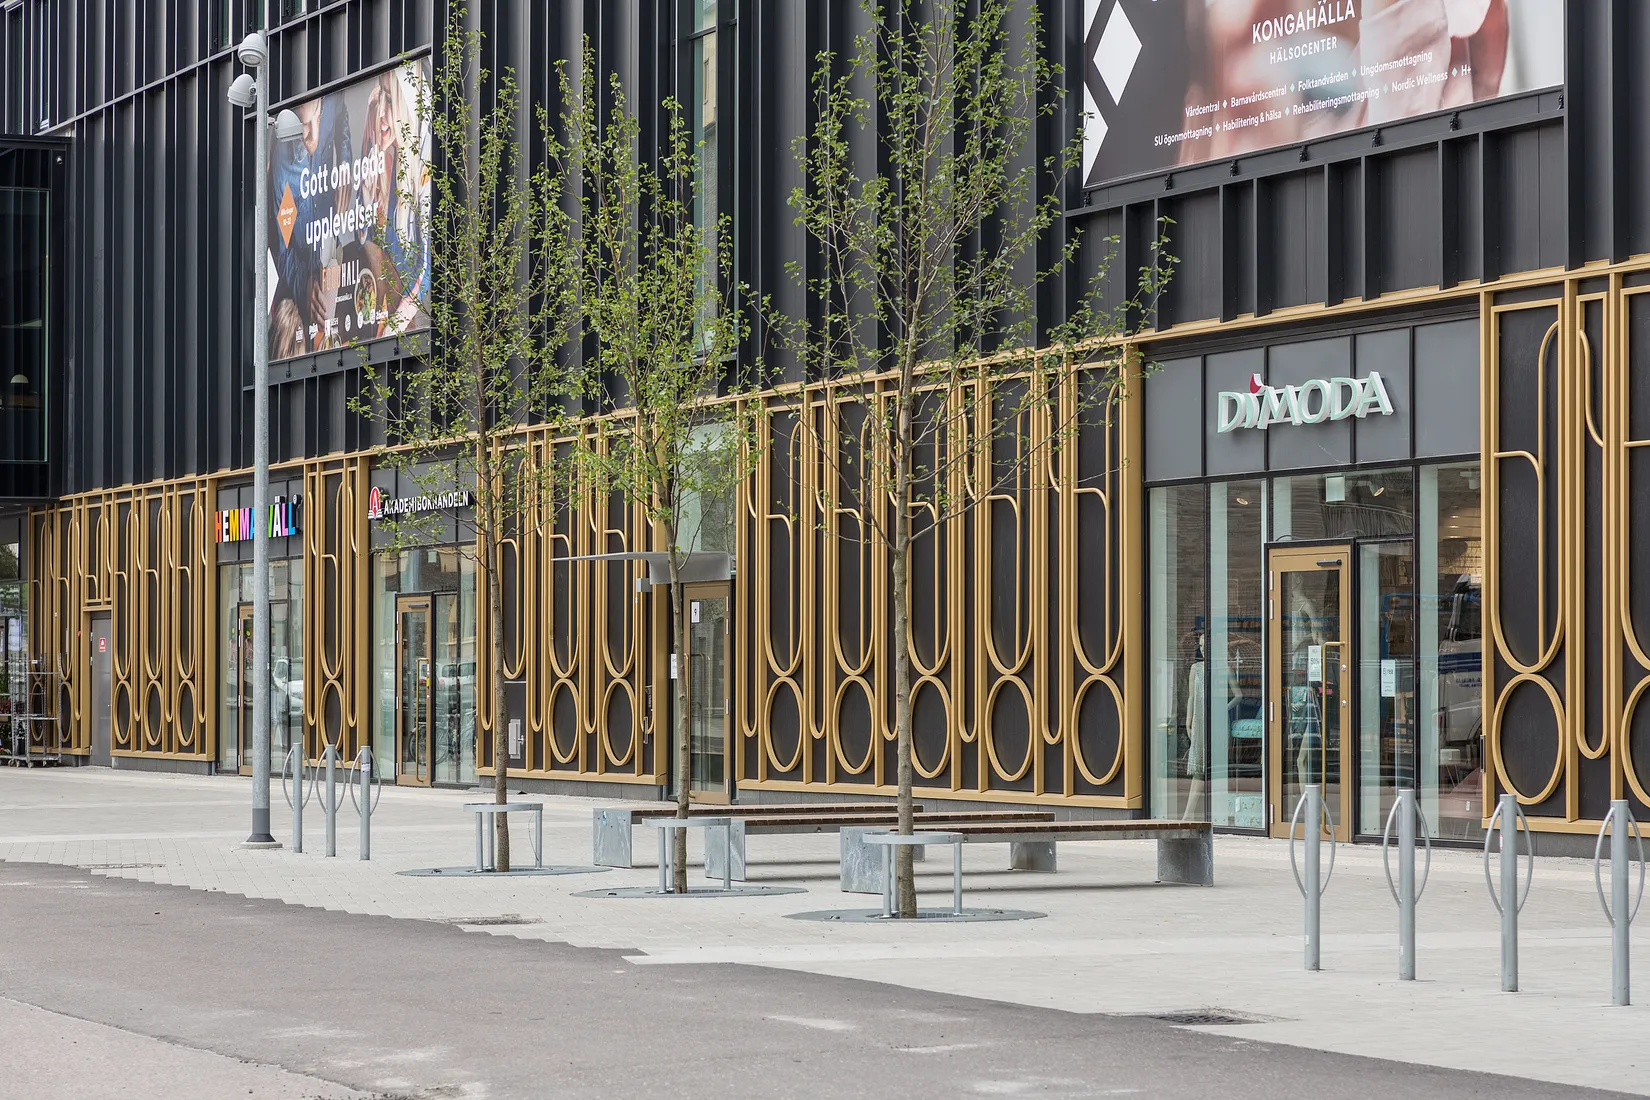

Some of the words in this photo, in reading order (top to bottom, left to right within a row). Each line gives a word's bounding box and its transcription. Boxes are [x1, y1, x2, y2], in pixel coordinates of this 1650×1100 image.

[1252, 0, 1356, 44] KONGAHÄLLA
[1270, 36, 1337, 64] HÄLSOCENTER
[1154, 135, 1163, 146] SU
[1164, 126, 1212, 146] ögonmottagning
[1222, 115, 1259, 132] Habilitering
[1260, 112, 1265, 123] &
[1265, 110, 1282, 122] hälsa
[1293, 87, 1380, 115] Rehabiliteringsmottagning
[1392, 76, 1415, 93] Nordic
[1416, 70, 1448, 86] Wellness
[1461, 65, 1472, 77] H+
[1185, 101, 1220, 117] Vårdcentral
[1230, 85, 1287, 107] Barnavårdscentral
[1298, 71, 1349, 92] Folktandvården
[1360, 51, 1433, 76] Ungdomsmottagning
[300, 164, 328, 199] Gott
[331, 161, 350, 190] om
[353, 144, 385, 191] goda
[306, 198, 378, 251] upplevelser
[215, 495, 296, 543] HEMMAVÄLL
[384, 491, 469, 515] AKADEMIBOKHANDELN
